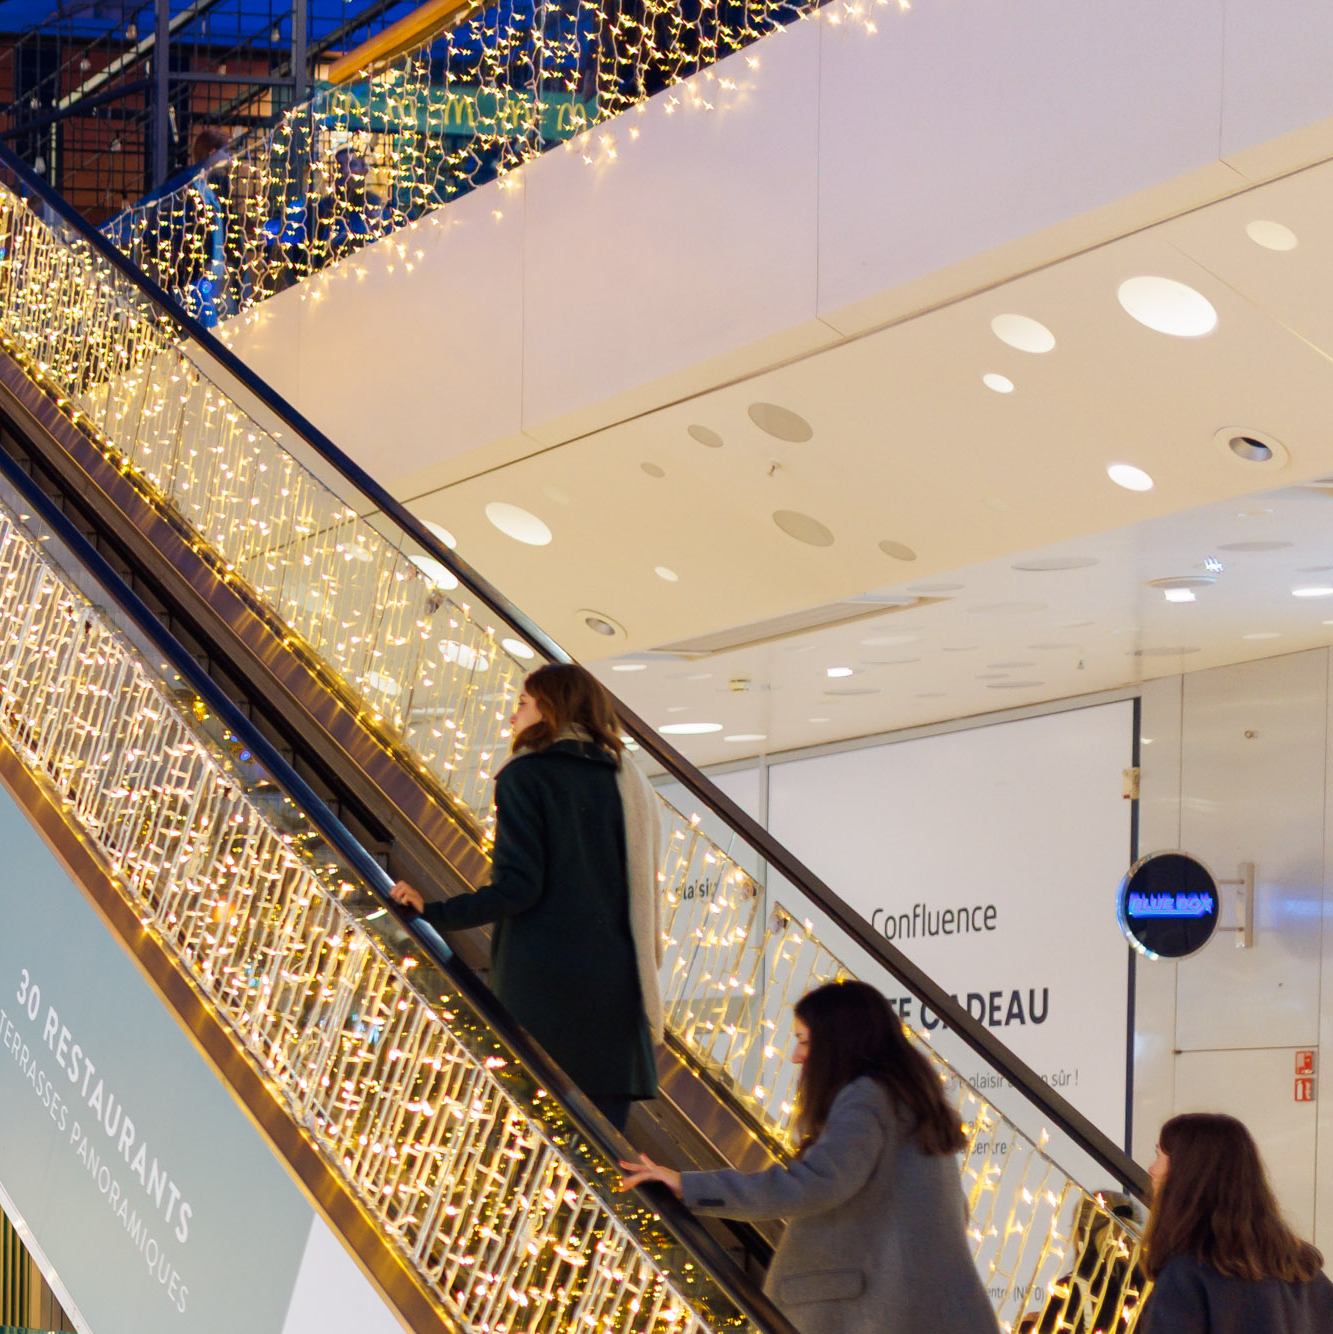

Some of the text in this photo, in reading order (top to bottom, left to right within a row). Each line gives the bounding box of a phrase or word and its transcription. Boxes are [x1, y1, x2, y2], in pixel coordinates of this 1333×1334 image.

[872, 903, 997, 940] Confluence
[16, 968, 193, 1243] 30 RESTAURANTS
[1052, 1070, 1071, 1086] sûr
[69, 1121, 190, 1314] PANORAMIQUES
